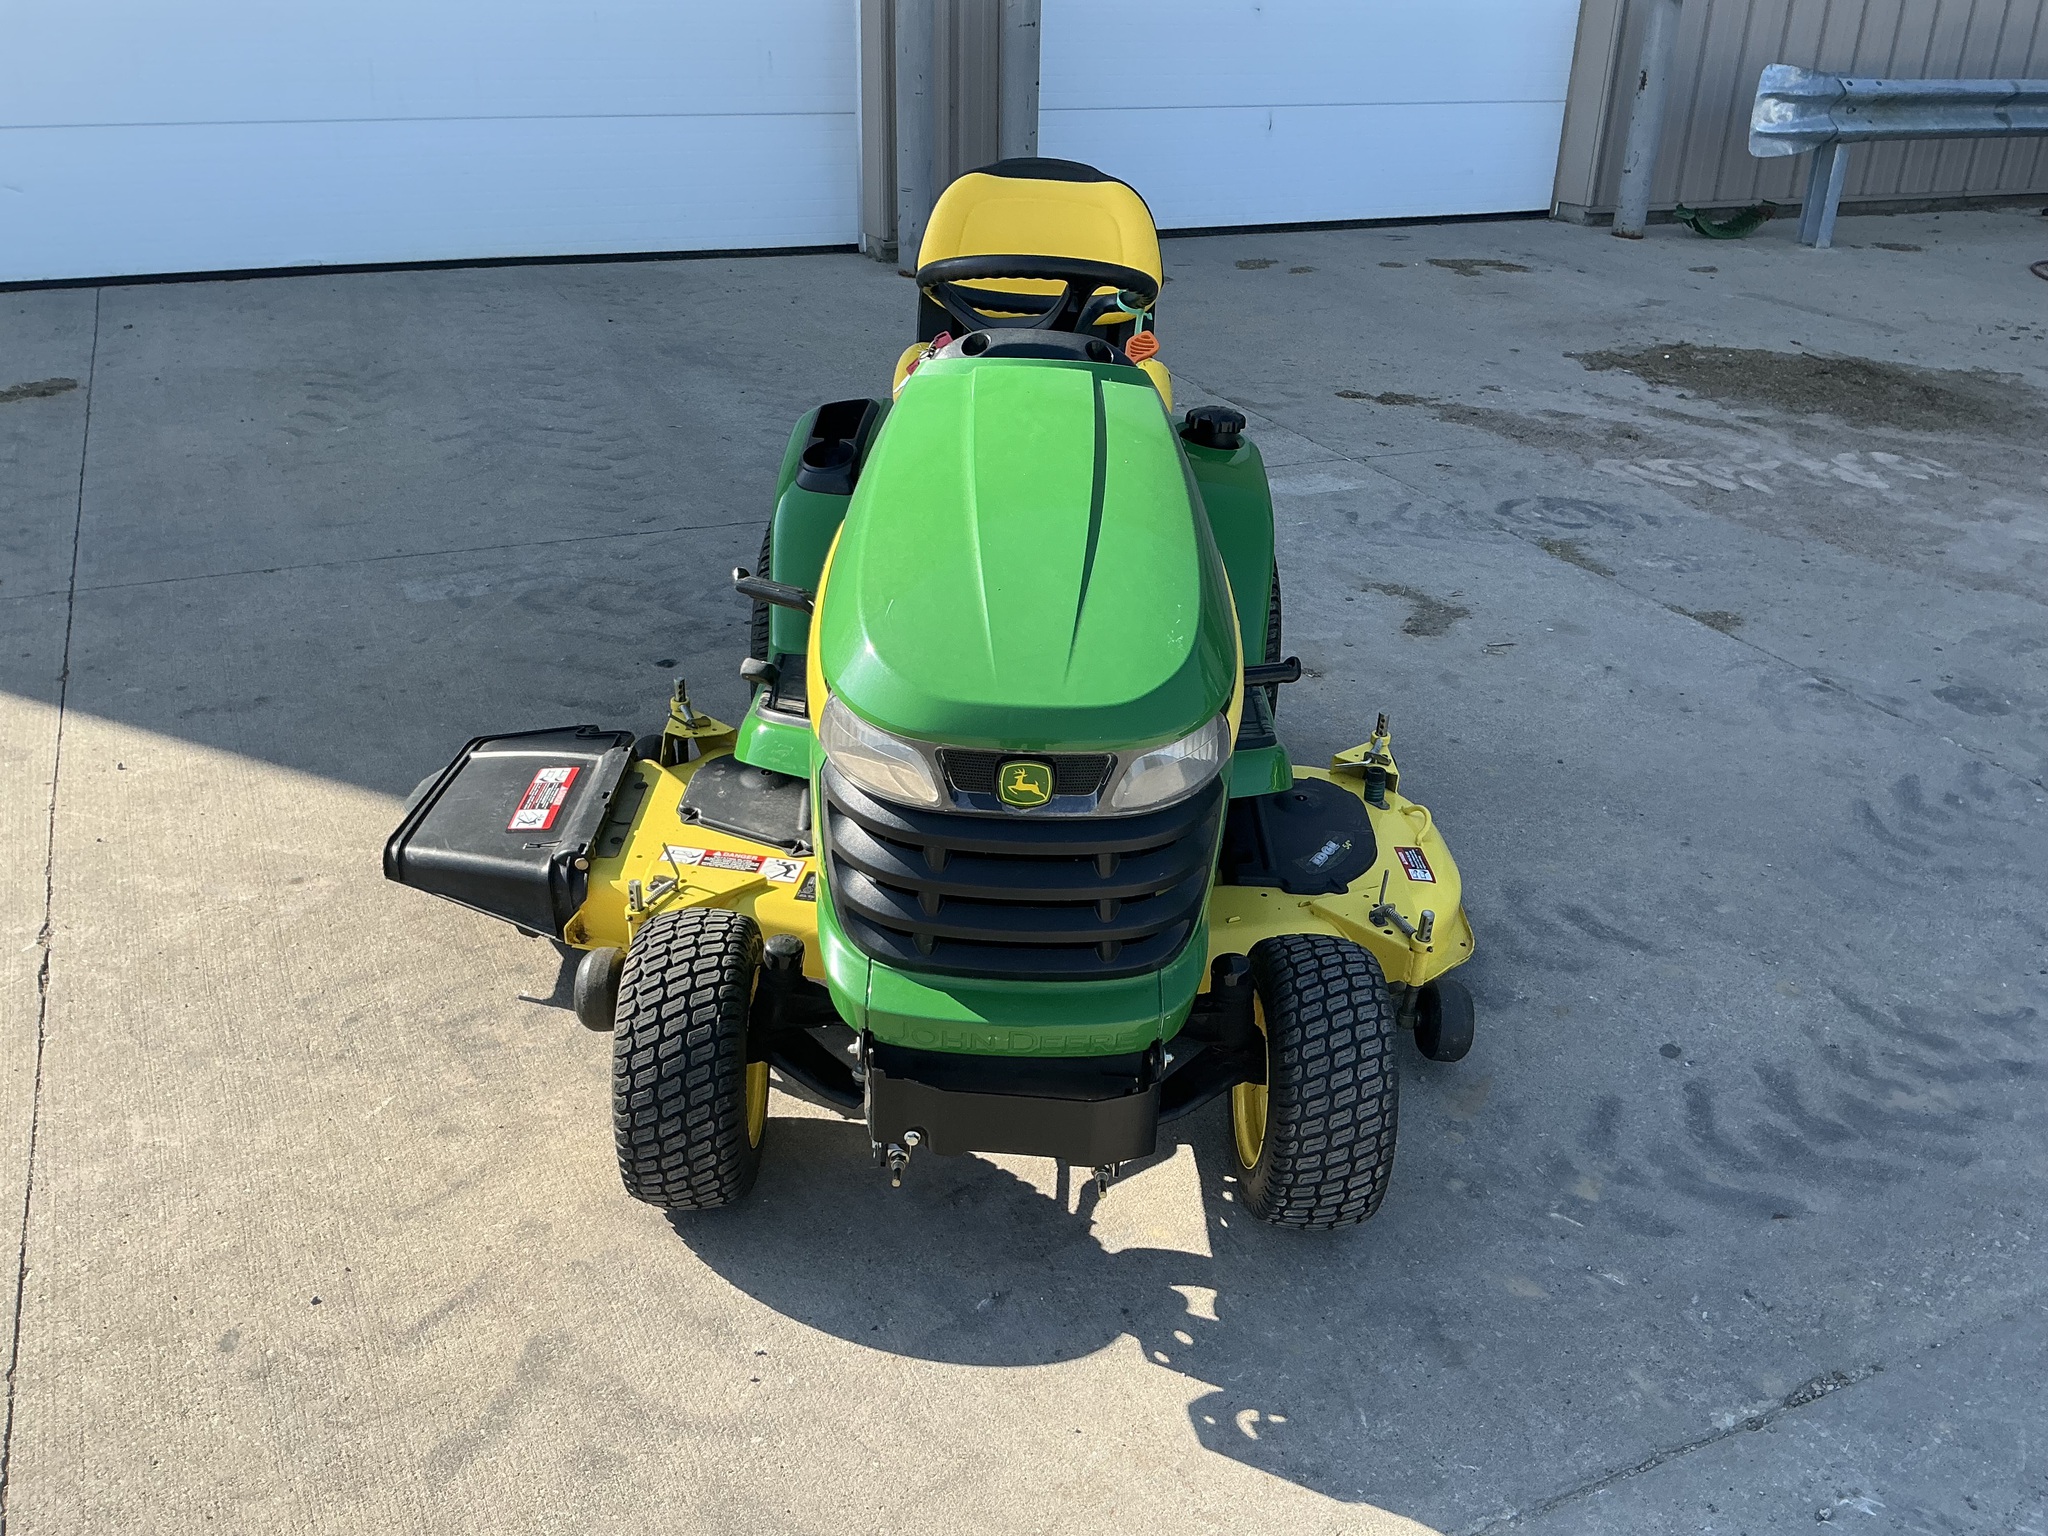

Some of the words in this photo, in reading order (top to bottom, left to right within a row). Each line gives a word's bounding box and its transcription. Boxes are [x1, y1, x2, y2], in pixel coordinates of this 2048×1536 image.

[723, 851, 758, 860] DANGER
[889, 1021, 995, 1051] JOHN
[1008, 1030, 1140, 1052] DEERE
